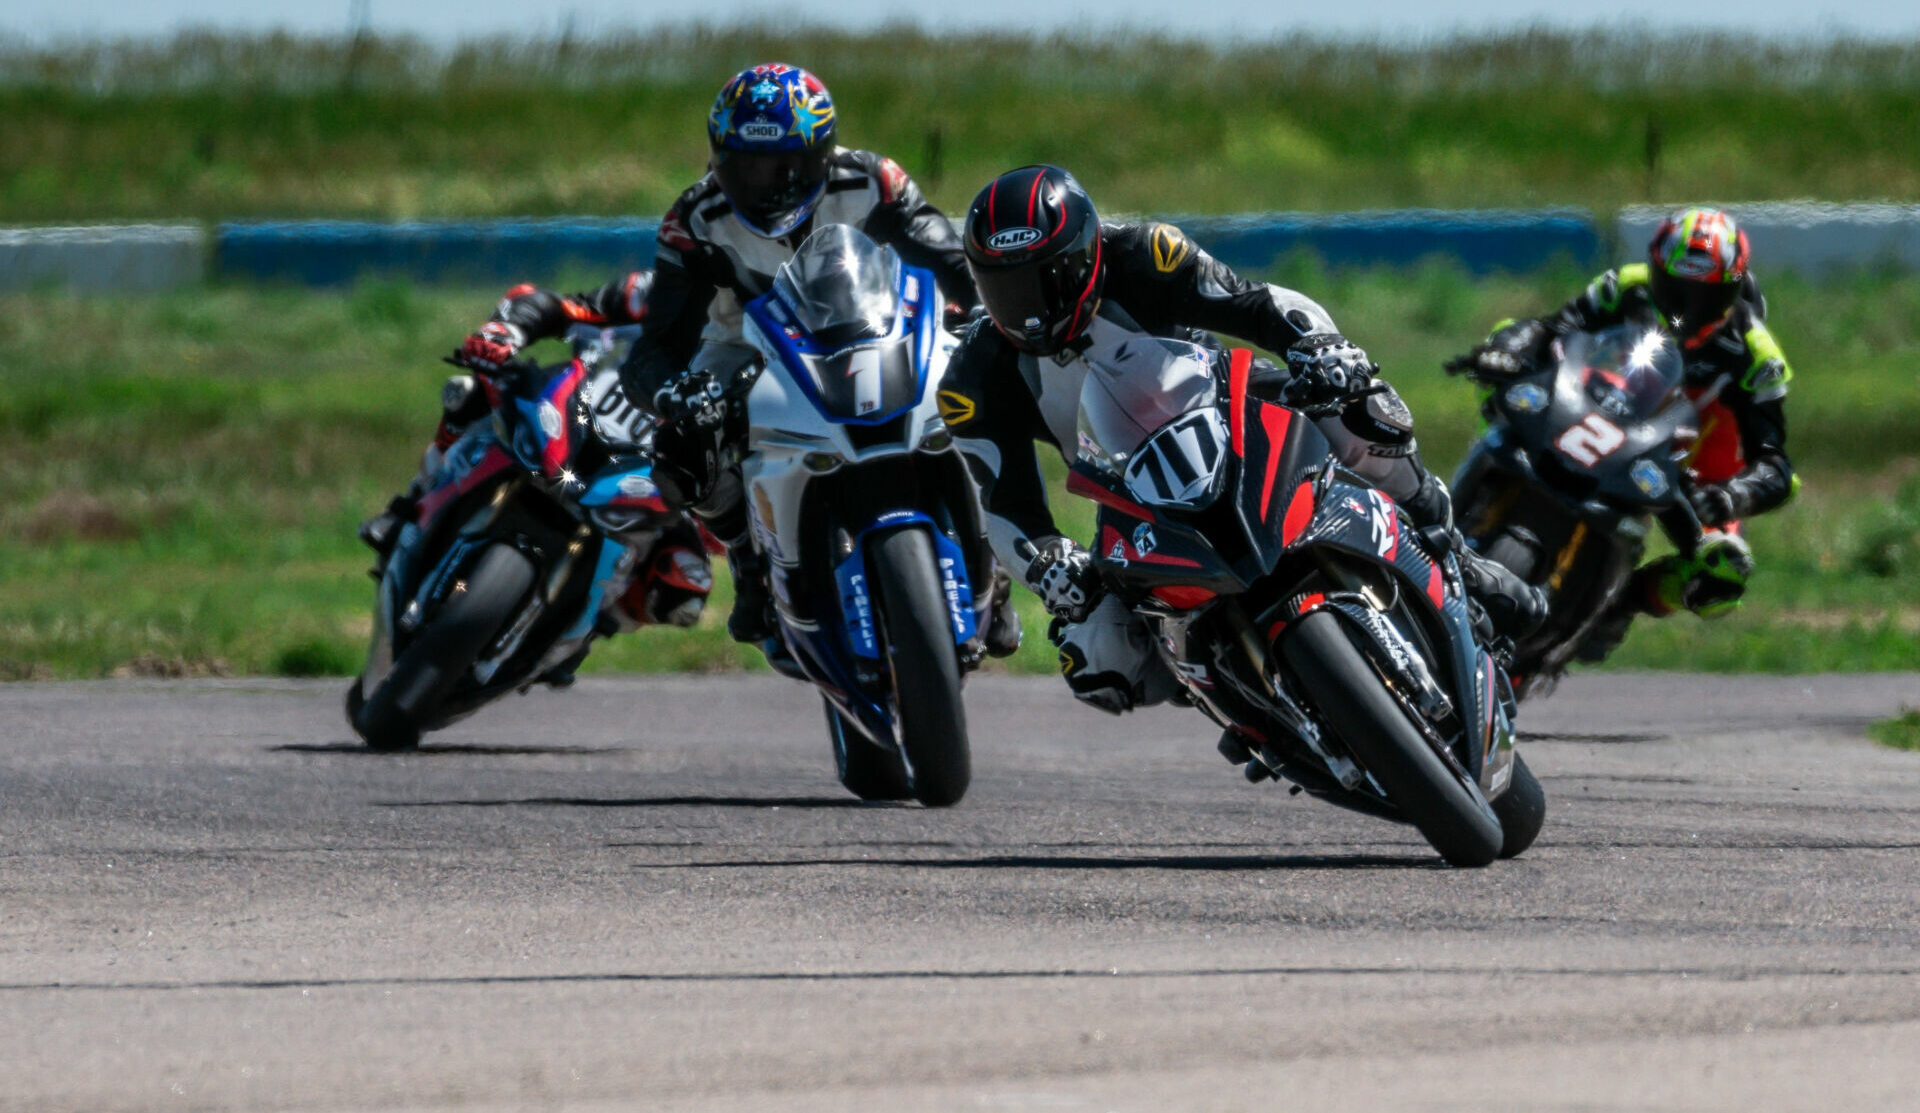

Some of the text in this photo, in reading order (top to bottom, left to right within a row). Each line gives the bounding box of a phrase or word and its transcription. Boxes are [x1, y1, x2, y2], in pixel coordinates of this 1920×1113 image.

[746, 125, 778, 137] SHOEI
[993, 230, 1034, 247] HJC
[846, 348, 881, 416] 1
[860, 400, 875, 411] 79
[1130, 412, 1219, 501] 717
[1554, 412, 1626, 467] 2
